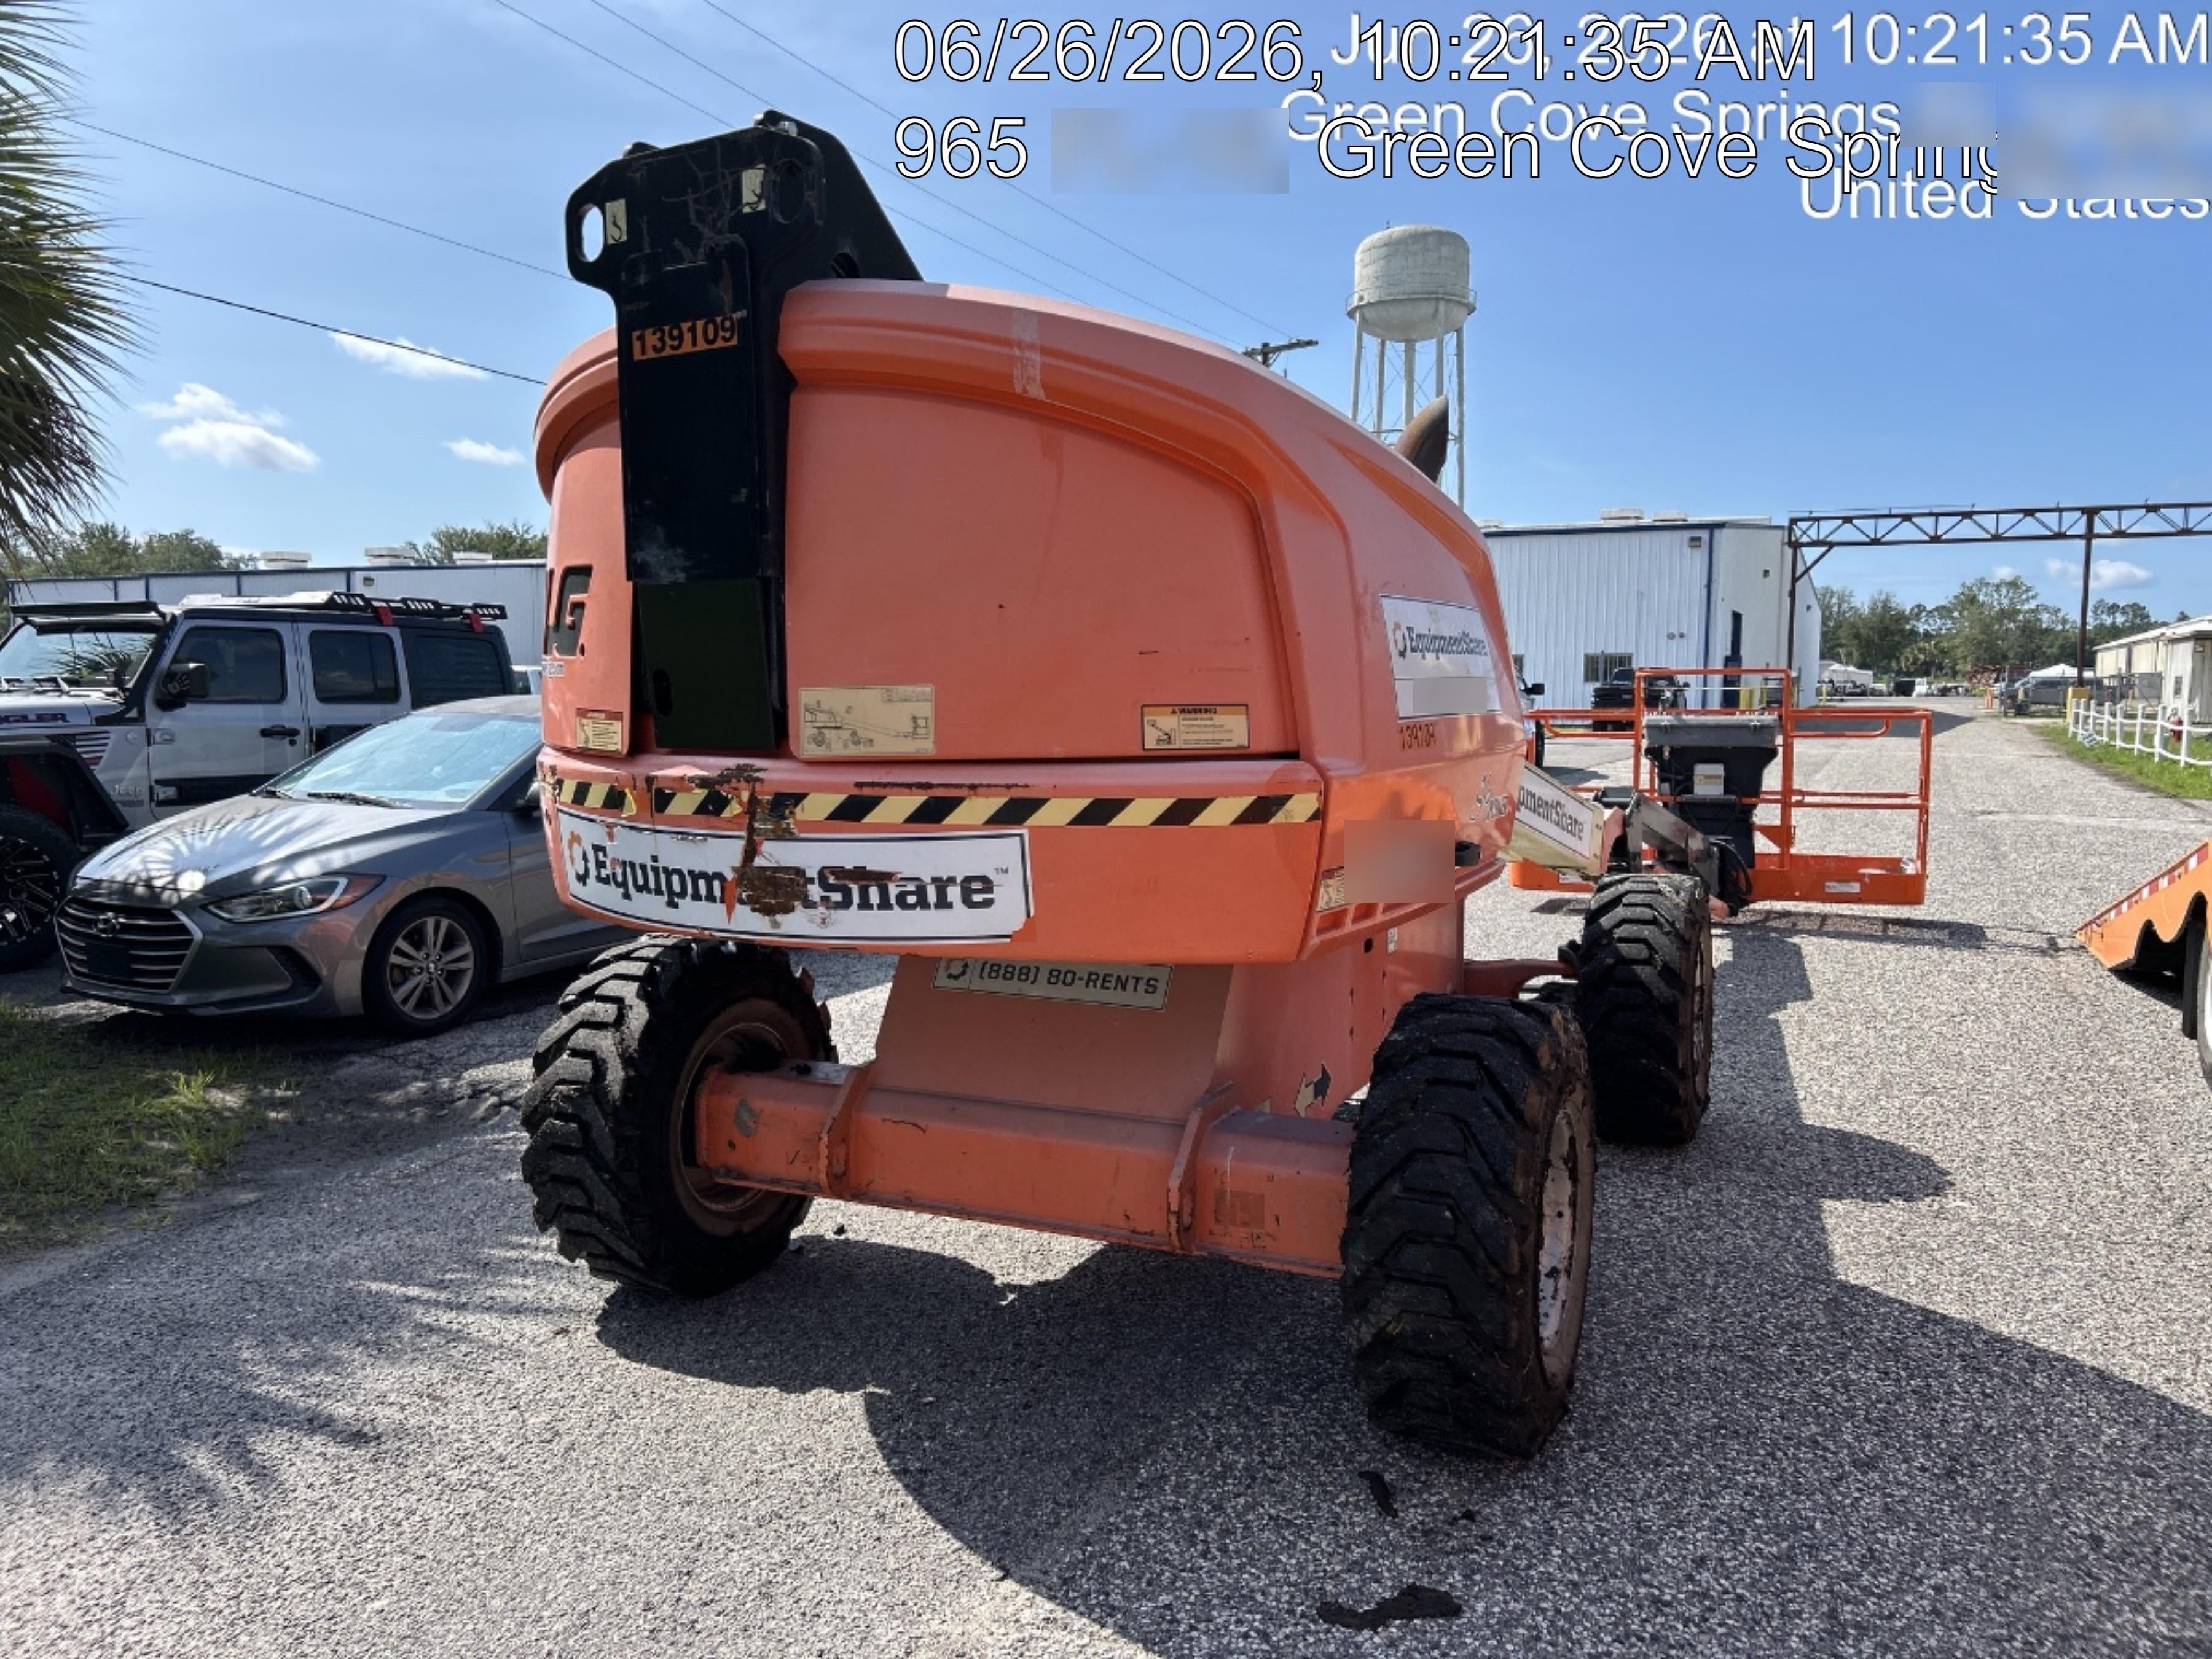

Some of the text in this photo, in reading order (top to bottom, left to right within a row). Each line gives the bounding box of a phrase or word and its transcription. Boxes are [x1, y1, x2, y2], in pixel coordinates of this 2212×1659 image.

[635, 315, 736, 356] 139109
[0, 712, 71, 724] GLER
[1516, 786, 1585, 841] pmentShare
[590, 844, 995, 912] EquipmtShare
[979, 960, 1159, 995] (888) 80-RENTS
